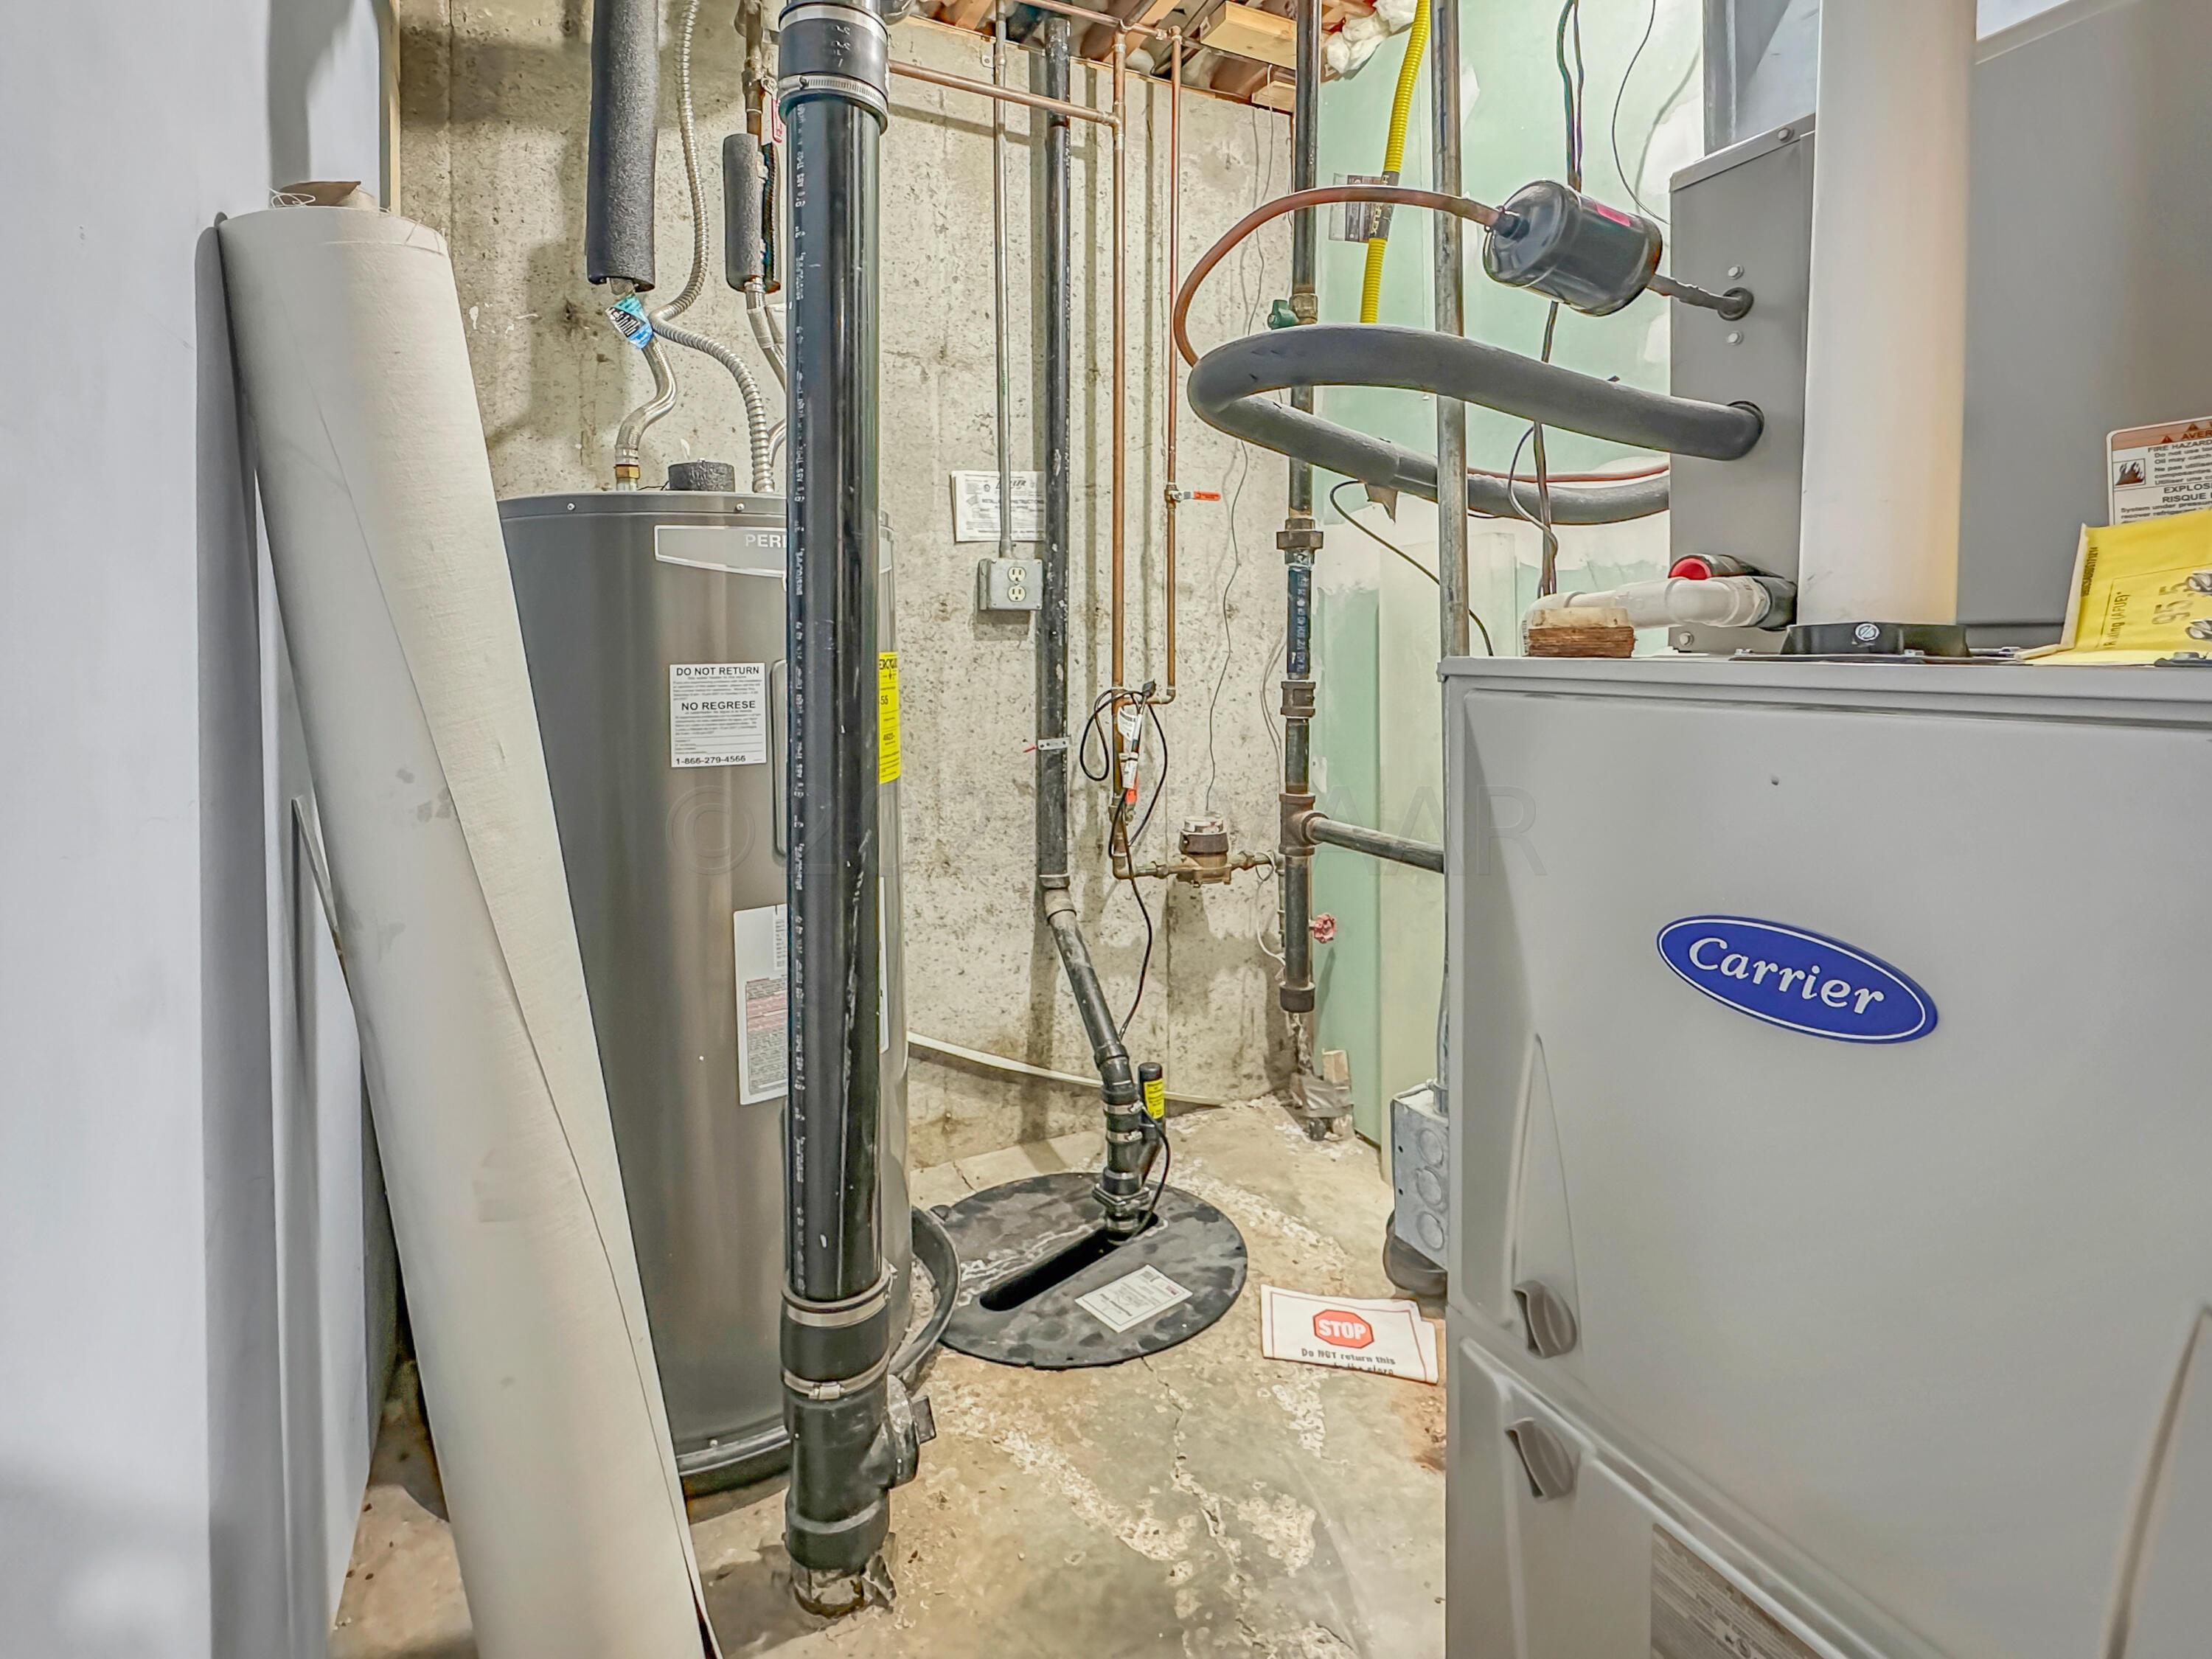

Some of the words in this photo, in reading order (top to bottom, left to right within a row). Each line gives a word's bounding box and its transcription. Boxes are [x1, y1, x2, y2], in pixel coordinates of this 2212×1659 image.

[2148, 445, 2168, 453] FIRE
[2172, 439, 2212, 449] HAZARD
[2163, 493, 2207, 503] RISQUE
[676, 667, 692, 676] DO
[695, 667, 716, 675] NOT
[719, 666, 759, 675] RETURN
[681, 702, 698, 711] NO
[702, 700, 756, 710] REGRESE
[1688, 936, 1885, 1015] Carrier
[1318, 1318, 1367, 1340] STOP
[1301, 1349, 1314, 1357] Do
[1318, 1349, 1336, 1359] NOT
[1340, 1353, 1373, 1363] return
[1376, 1356, 1396, 1365] this
